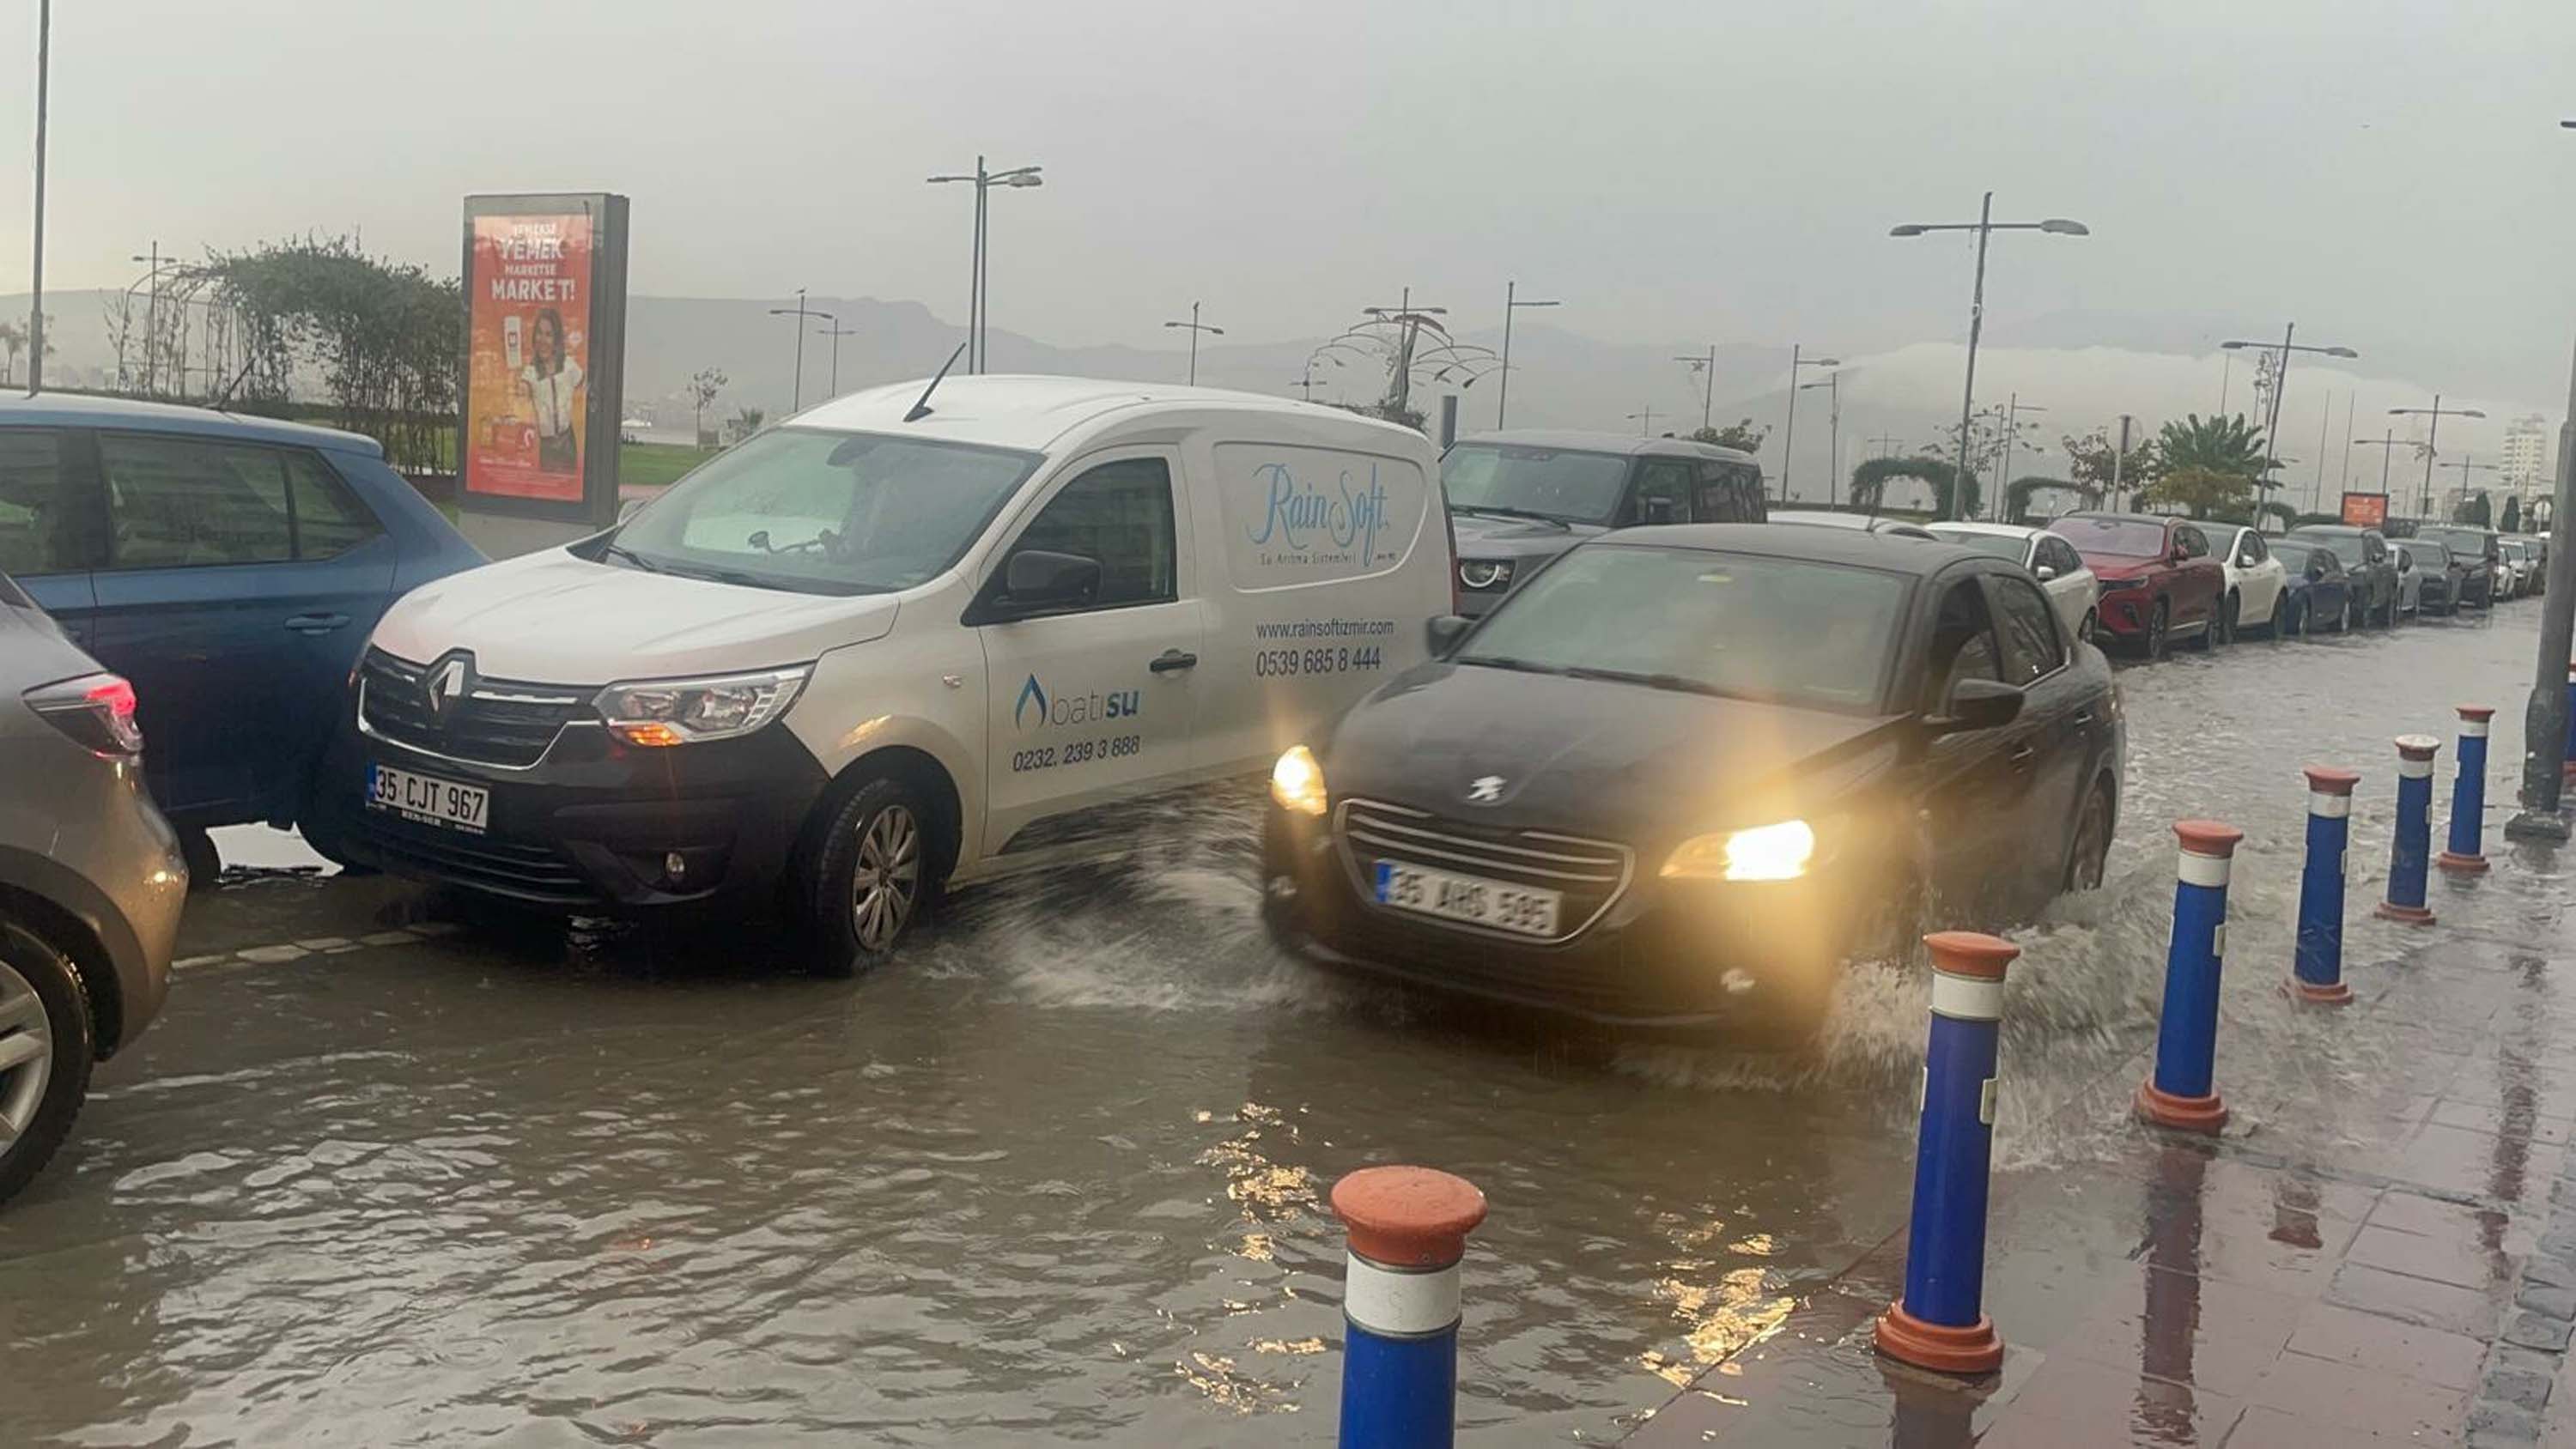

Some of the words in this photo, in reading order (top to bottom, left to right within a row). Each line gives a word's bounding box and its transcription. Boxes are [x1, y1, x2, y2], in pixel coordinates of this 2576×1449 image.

[499, 237, 564, 260] YEMEK
[491, 278, 576, 300] MARKET!
[1256, 618, 1394, 640] www.rainsoftizmir.com
[1256, 650, 1298, 676] 0539
[1303, 648, 1334, 674] 685
[1338, 648, 1347, 673] 8
[1352, 646, 1381, 670] 444
[1064, 742, 1093, 765] 239
[1097, 739, 1108, 759] 3
[1112, 735, 1140, 756] 888
[376, 770, 397, 801] 35
[406, 777, 440, 812] CJT
[447, 787, 484, 822] 967
[1391, 869, 1425, 905] 35
